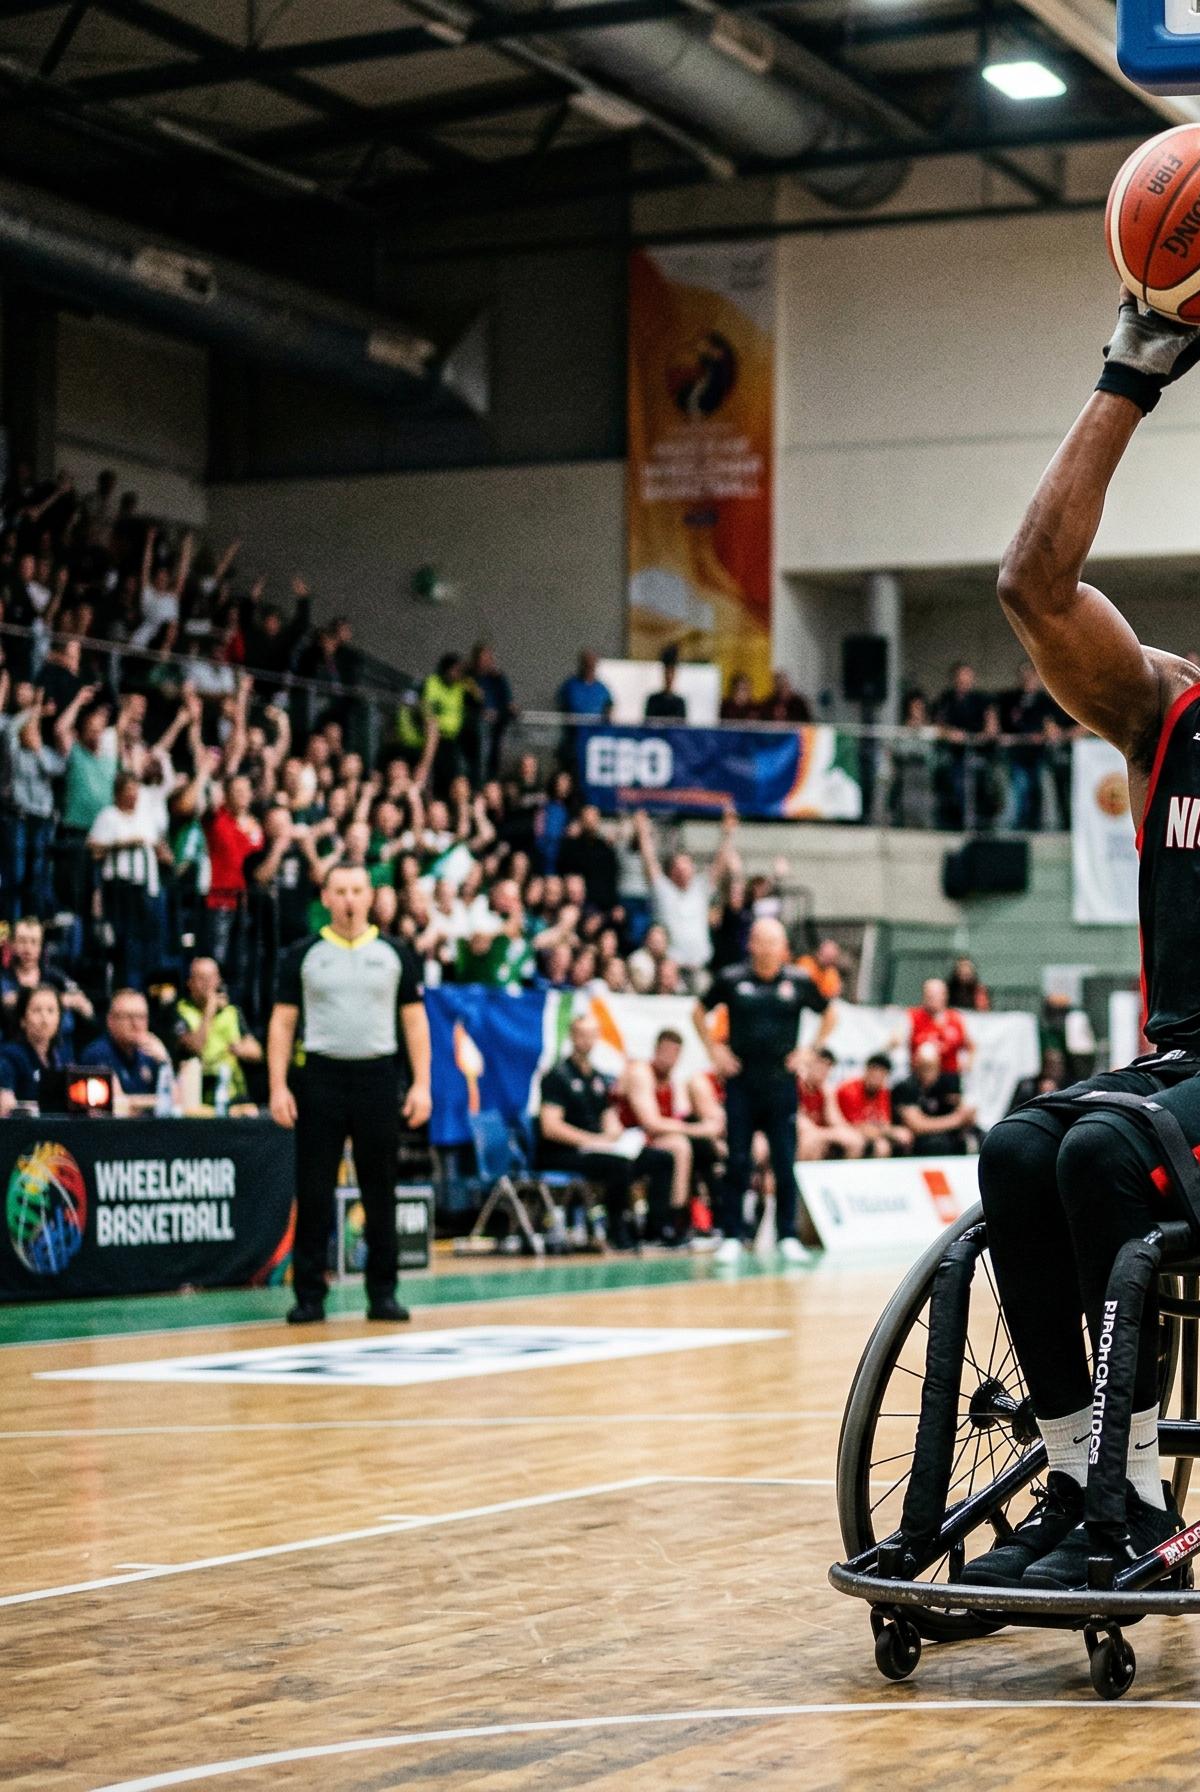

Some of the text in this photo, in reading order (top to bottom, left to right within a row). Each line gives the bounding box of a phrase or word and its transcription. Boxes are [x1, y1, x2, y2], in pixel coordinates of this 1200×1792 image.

[1147, 154, 1183, 196] FIBA
[95, 1157, 236, 1199] WHEELCHAIR
[96, 1202, 235, 1246] BASKETBALL
